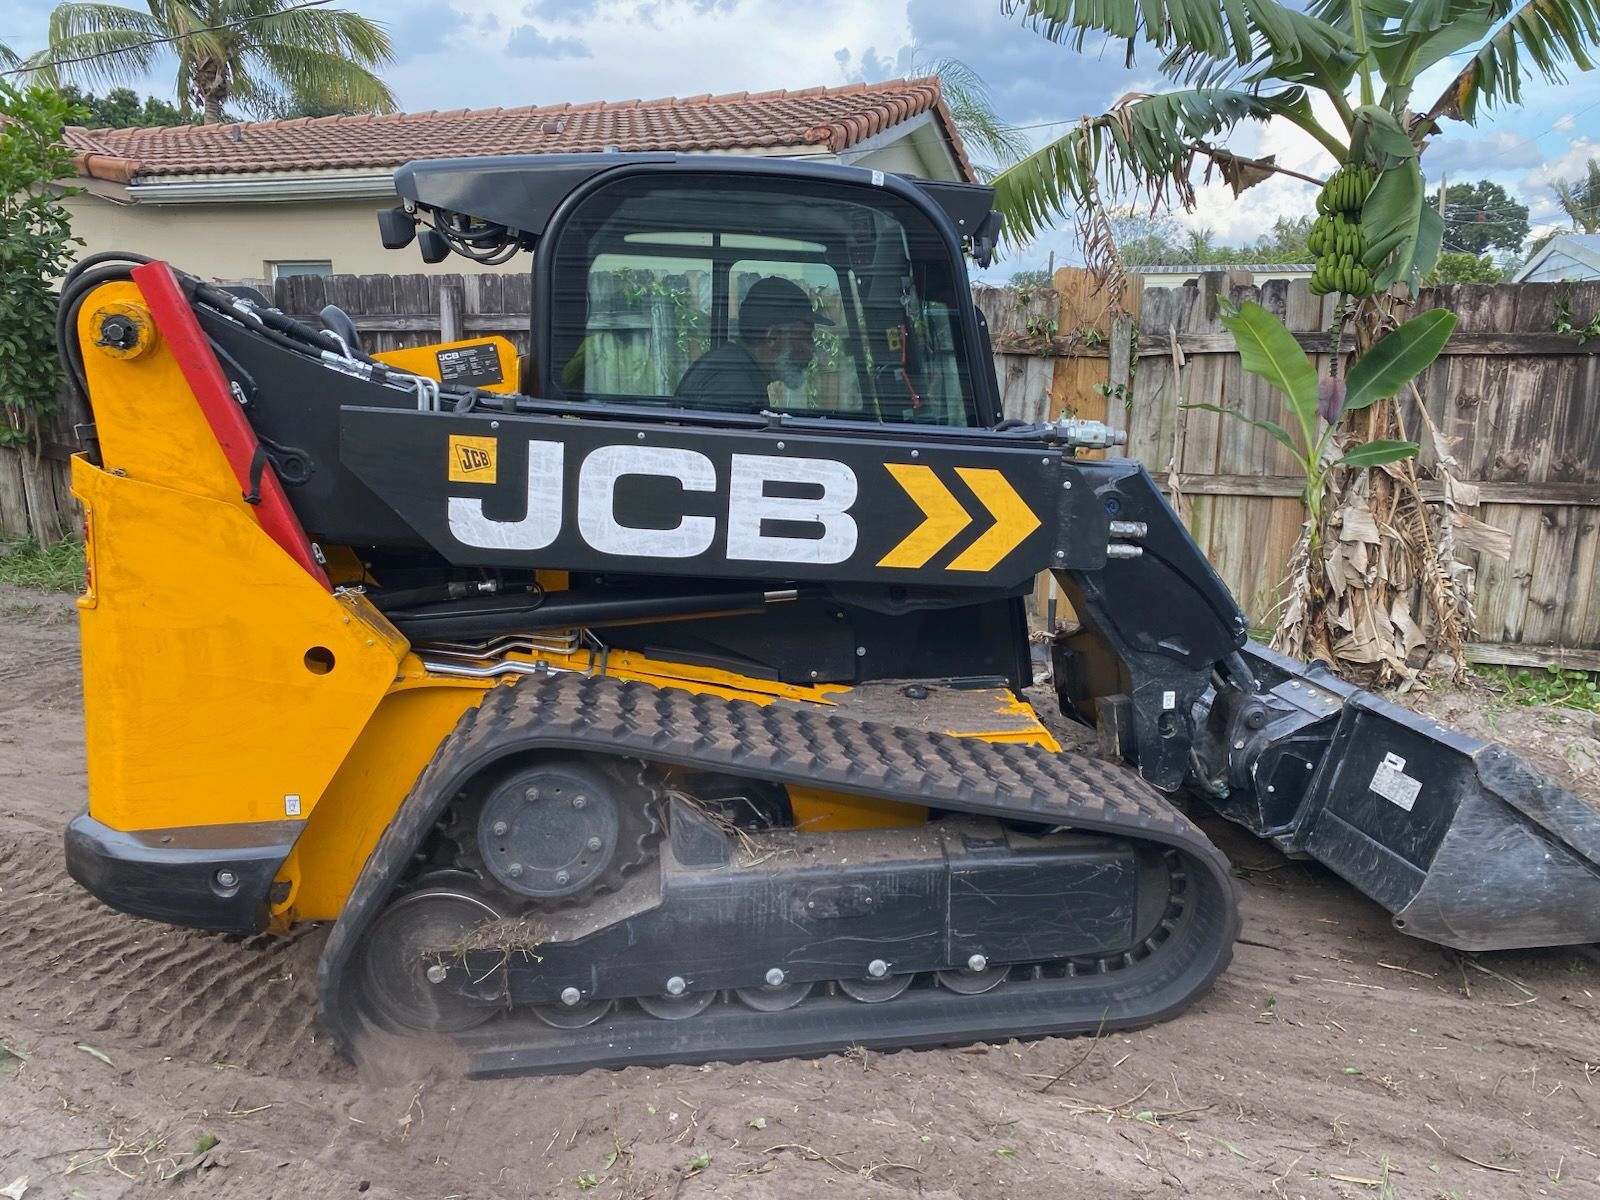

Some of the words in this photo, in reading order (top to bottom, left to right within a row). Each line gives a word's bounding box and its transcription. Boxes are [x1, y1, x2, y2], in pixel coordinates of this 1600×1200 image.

[438, 352, 459, 361] JCB
[462, 448, 489, 470] JCB
[448, 440, 858, 564] JCB
